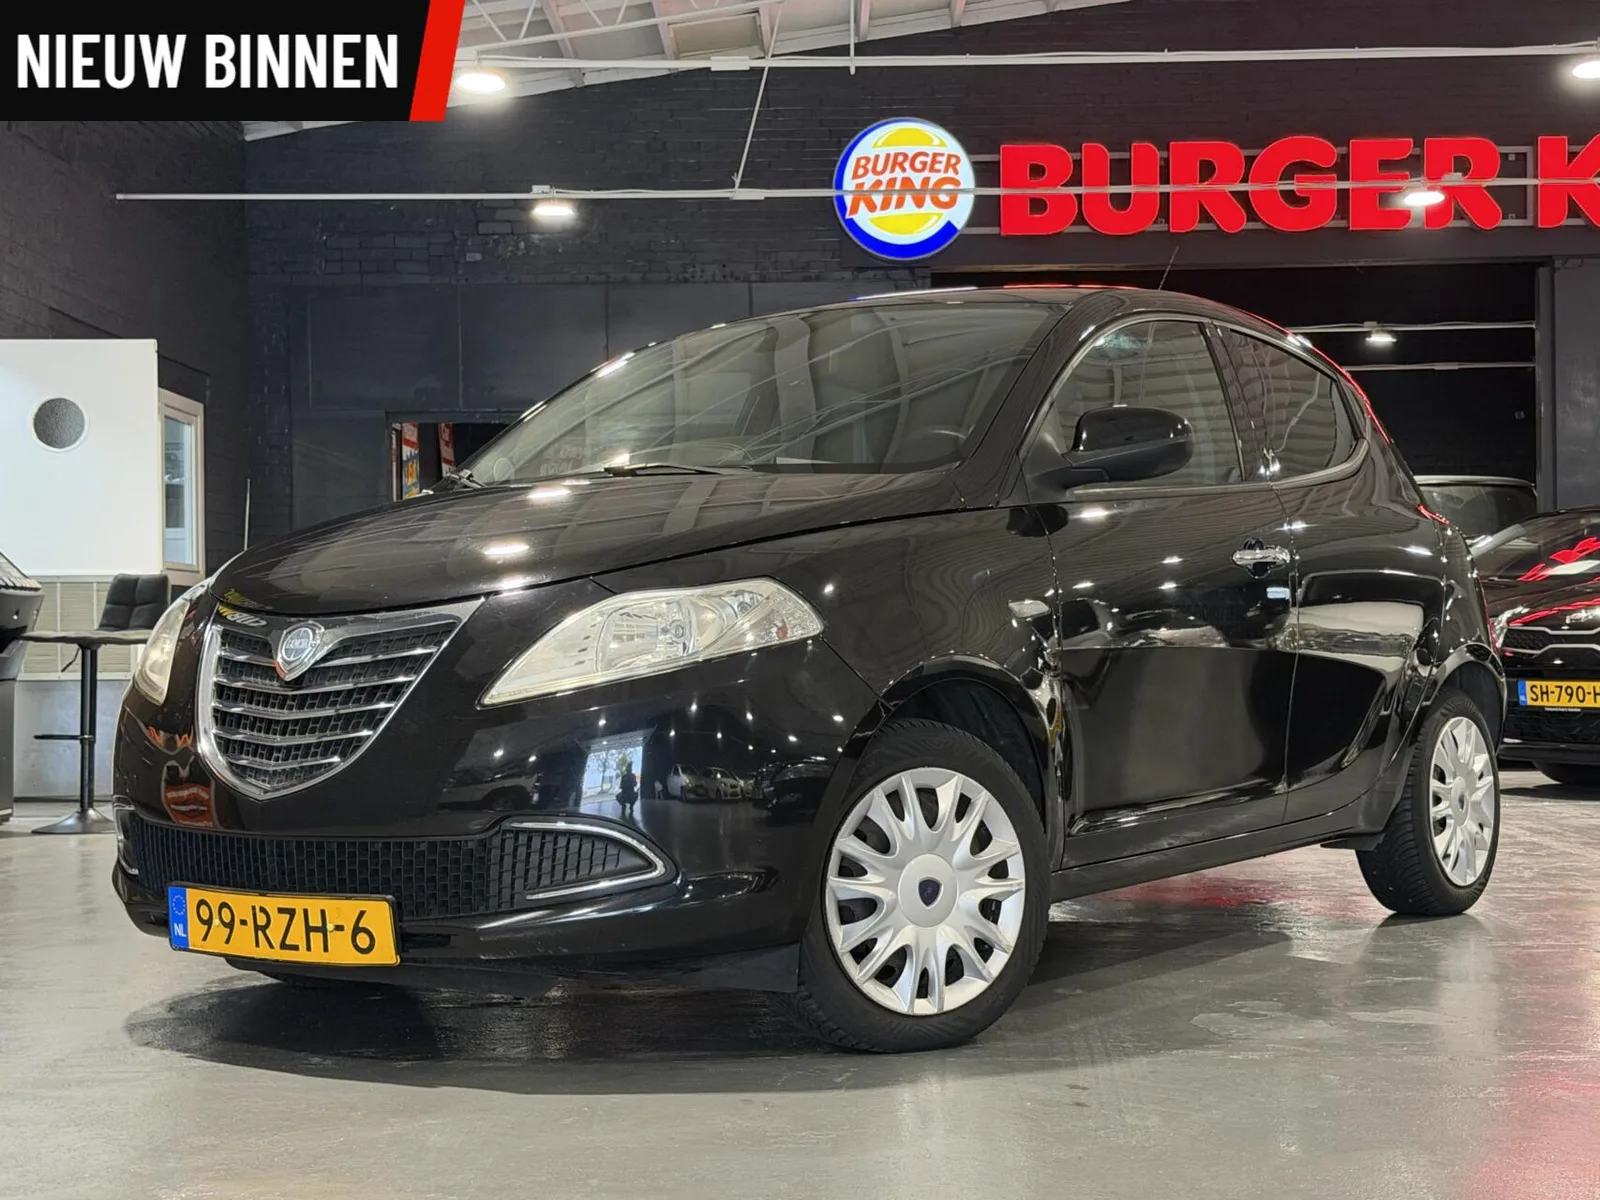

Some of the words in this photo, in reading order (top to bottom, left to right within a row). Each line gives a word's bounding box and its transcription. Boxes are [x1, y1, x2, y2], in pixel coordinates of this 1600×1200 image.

[852, 151, 961, 180] BURGER
[848, 177, 961, 216] KING
[1000, 136, 1502, 235] BURGER
[1530, 684, 1600, 703] SH-790-H
[174, 922, 187, 938] NL
[196, 898, 376, 955] 99-RZH-6
